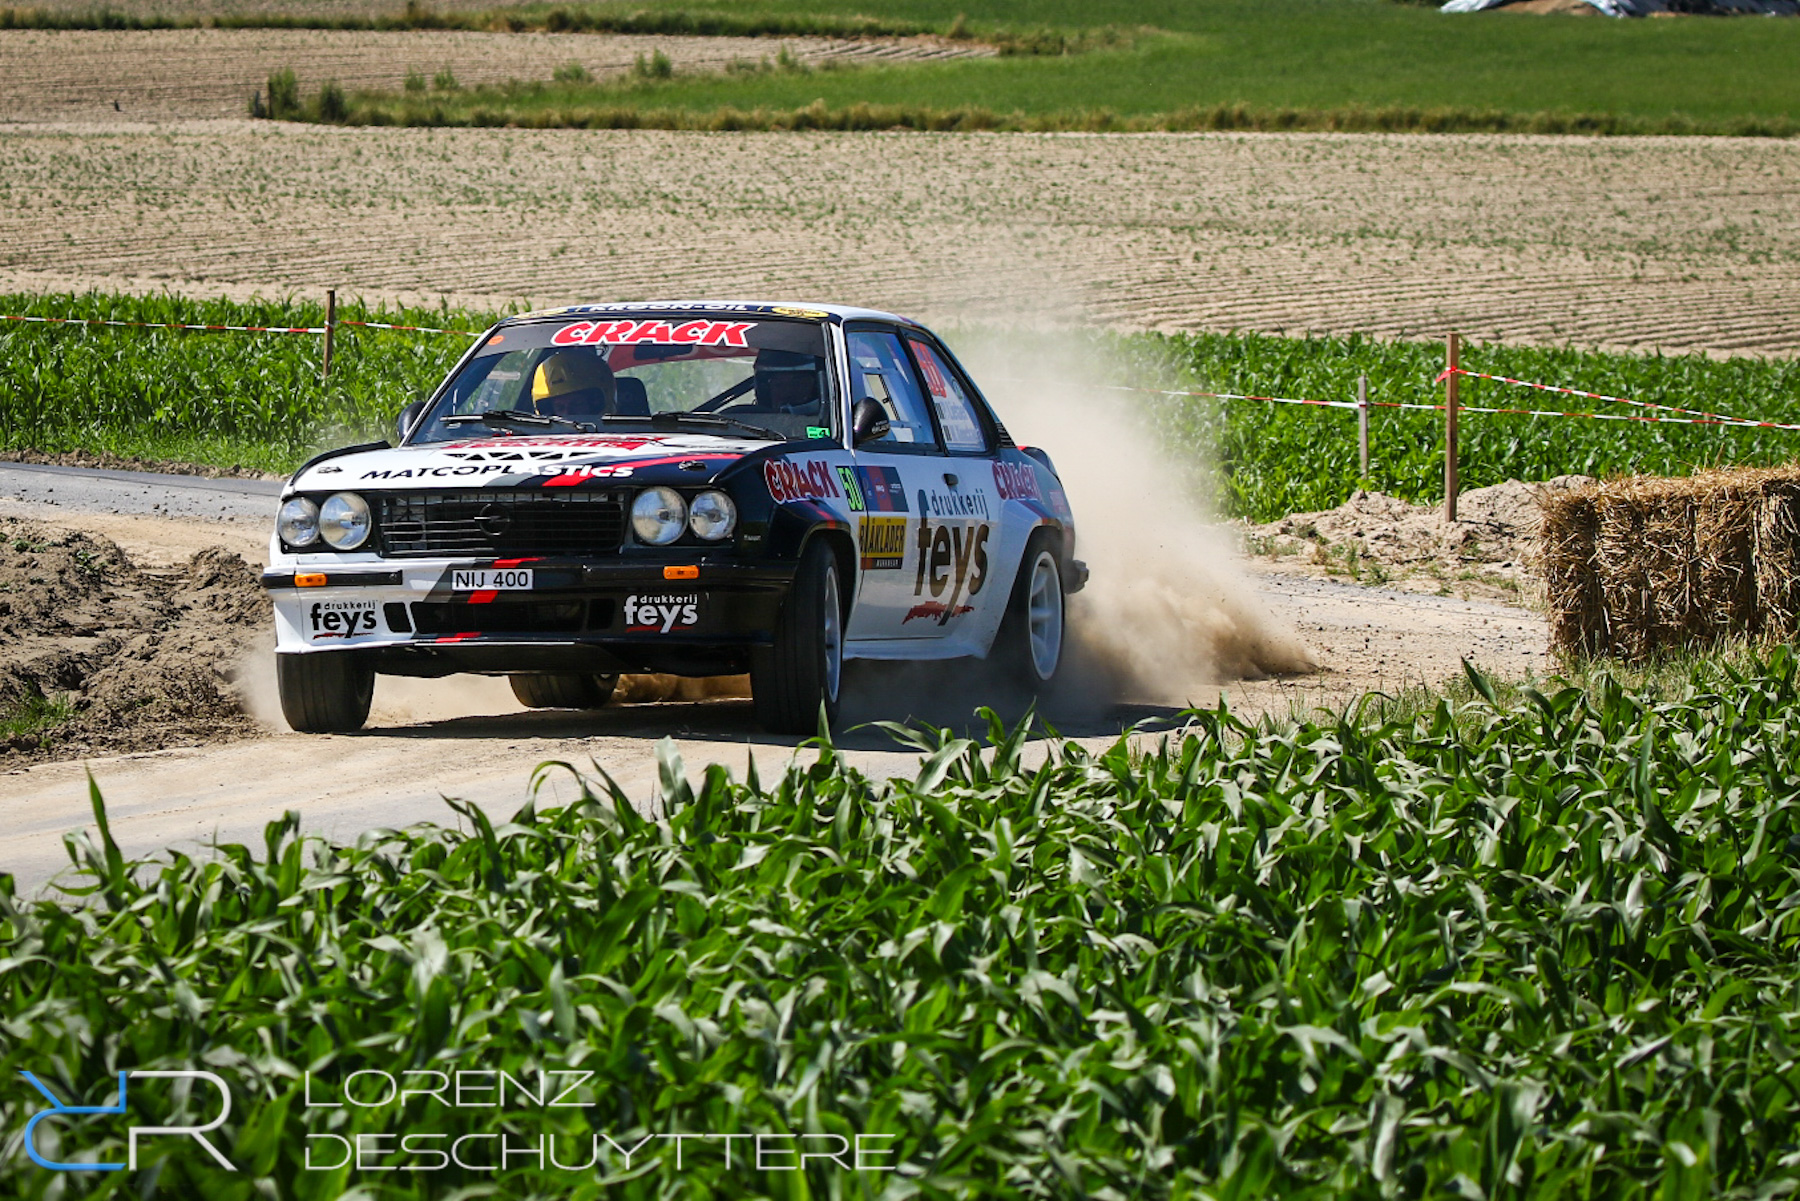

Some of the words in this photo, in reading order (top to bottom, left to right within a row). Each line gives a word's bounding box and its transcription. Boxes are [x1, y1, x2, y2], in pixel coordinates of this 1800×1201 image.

[551, 319, 758, 348] CRACK
[359, 464, 635, 480] MATCOPLASTICS
[763, 458, 841, 505] CRACK
[836, 466, 865, 511] 50
[991, 459, 1044, 504] CRACK
[931, 488, 990, 521] drukkerij
[913, 488, 991, 627] feys
[455, 571, 485, 588] NIJ
[493, 571, 529, 587] 400
[324, 600, 377, 610] drukkerij
[623, 595, 699, 634] feys
[639, 593, 698, 604] drukkerij
[310, 602, 377, 639] feys
